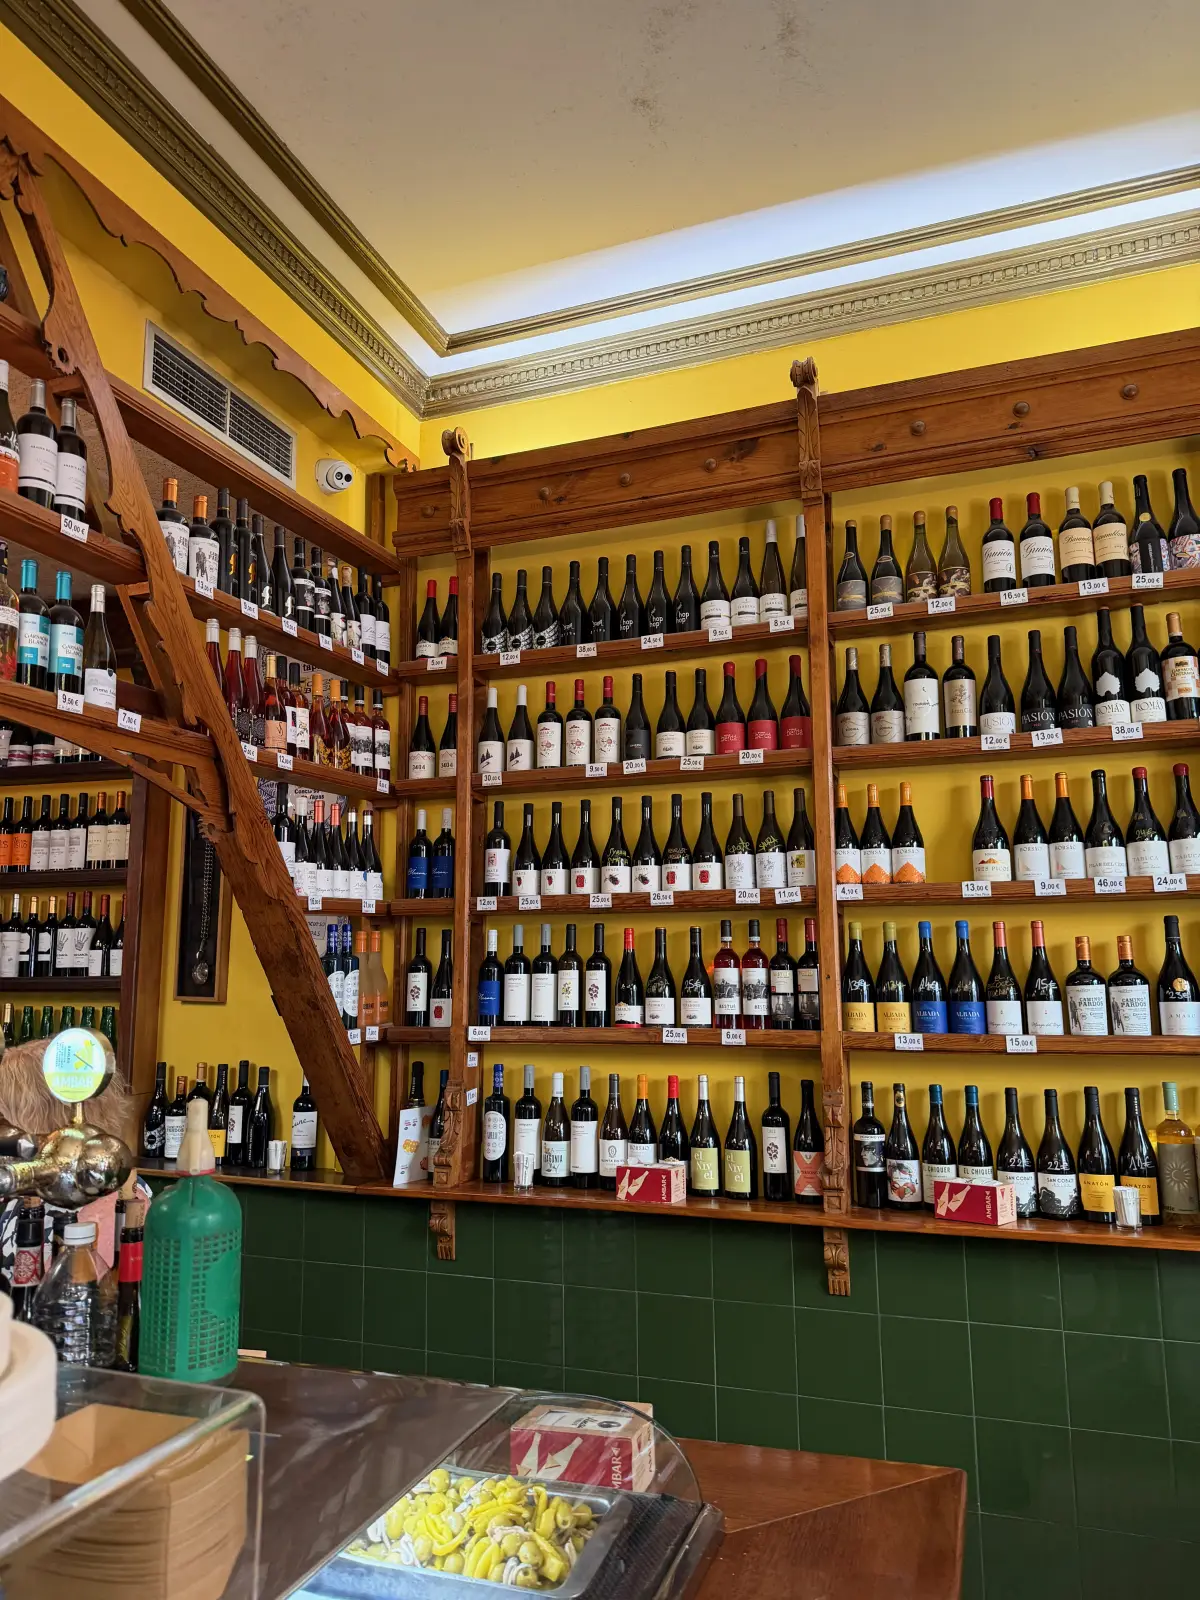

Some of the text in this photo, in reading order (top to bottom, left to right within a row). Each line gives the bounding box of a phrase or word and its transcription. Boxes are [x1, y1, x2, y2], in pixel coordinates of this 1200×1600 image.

[64, 519, 80, 533] 50,00
[1136, 576, 1154, 584] 25,00
[63, 694, 74, 705] 9,50
[1136, 699, 1164, 712] ROMÁN
[1022, 710, 1054, 724] PASIÓN
[1059, 706, 1092, 720] PASIÓN
[1115, 726, 1134, 734] 38,00
[1036, 733, 1054, 741] 13,00
[1098, 879, 1117, 887] 46,00
[1157, 877, 1177, 885] 24,00
[966, 884, 983, 892] 13,00
[1010, 1038, 1028, 1047] 15,00
[611, 1456, 621, 1489] MBAR
